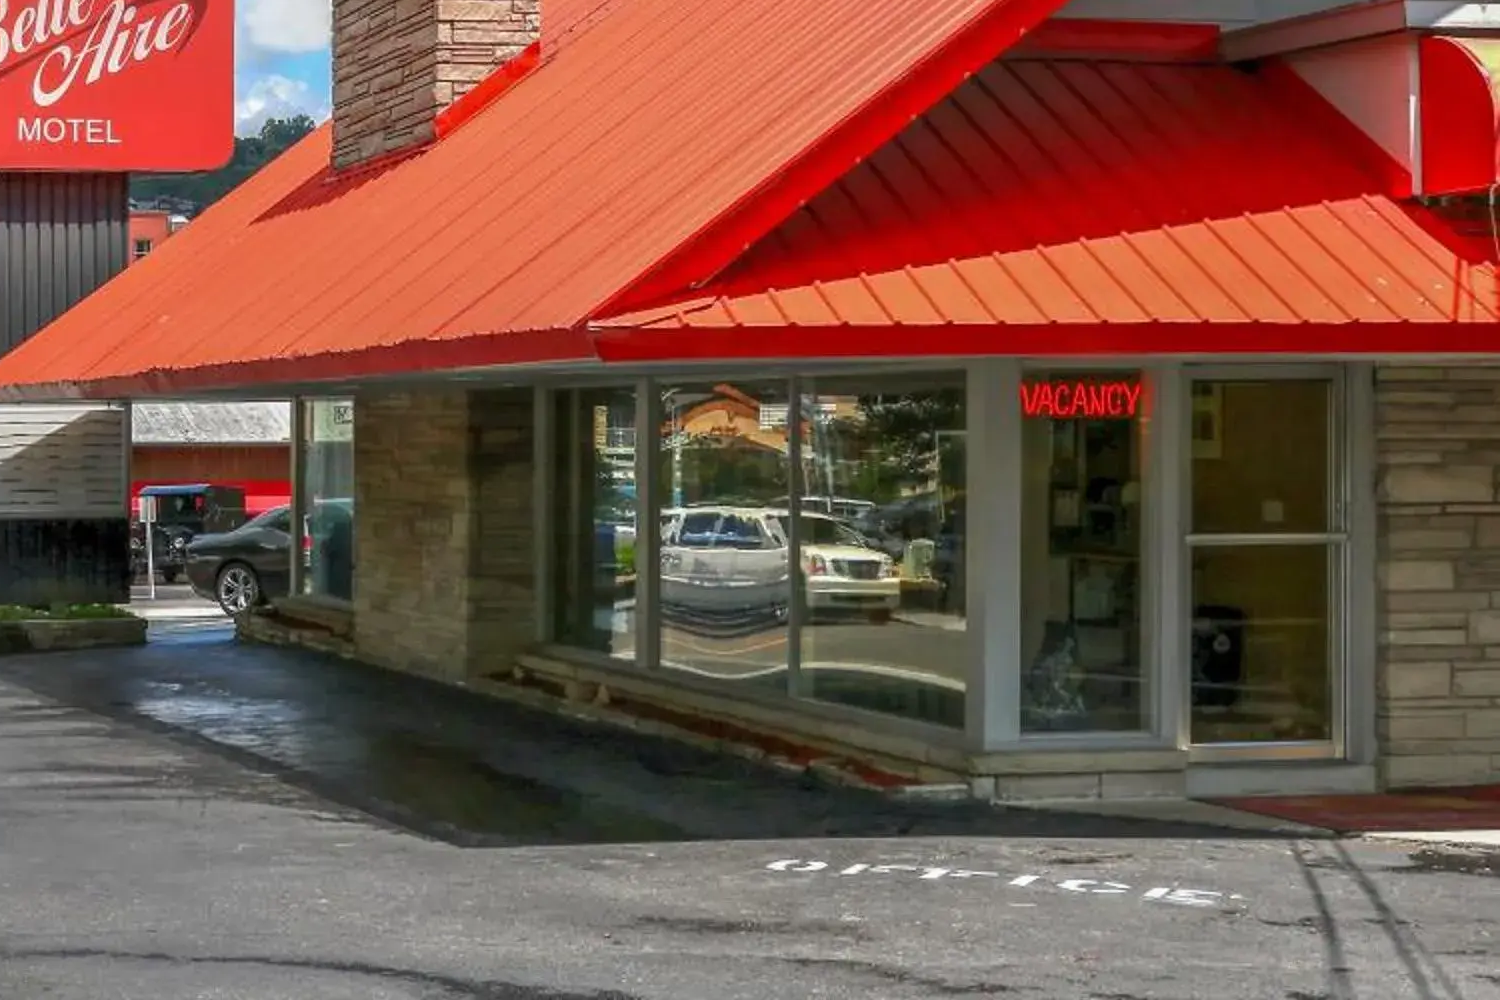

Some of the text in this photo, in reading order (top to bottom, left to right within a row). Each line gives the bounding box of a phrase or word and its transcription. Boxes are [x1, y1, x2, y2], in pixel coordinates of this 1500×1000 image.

[17, 117, 123, 144] MOTEL
[1019, 380, 1141, 417] VACANCY
[765, 858, 1224, 907] OFFICE
